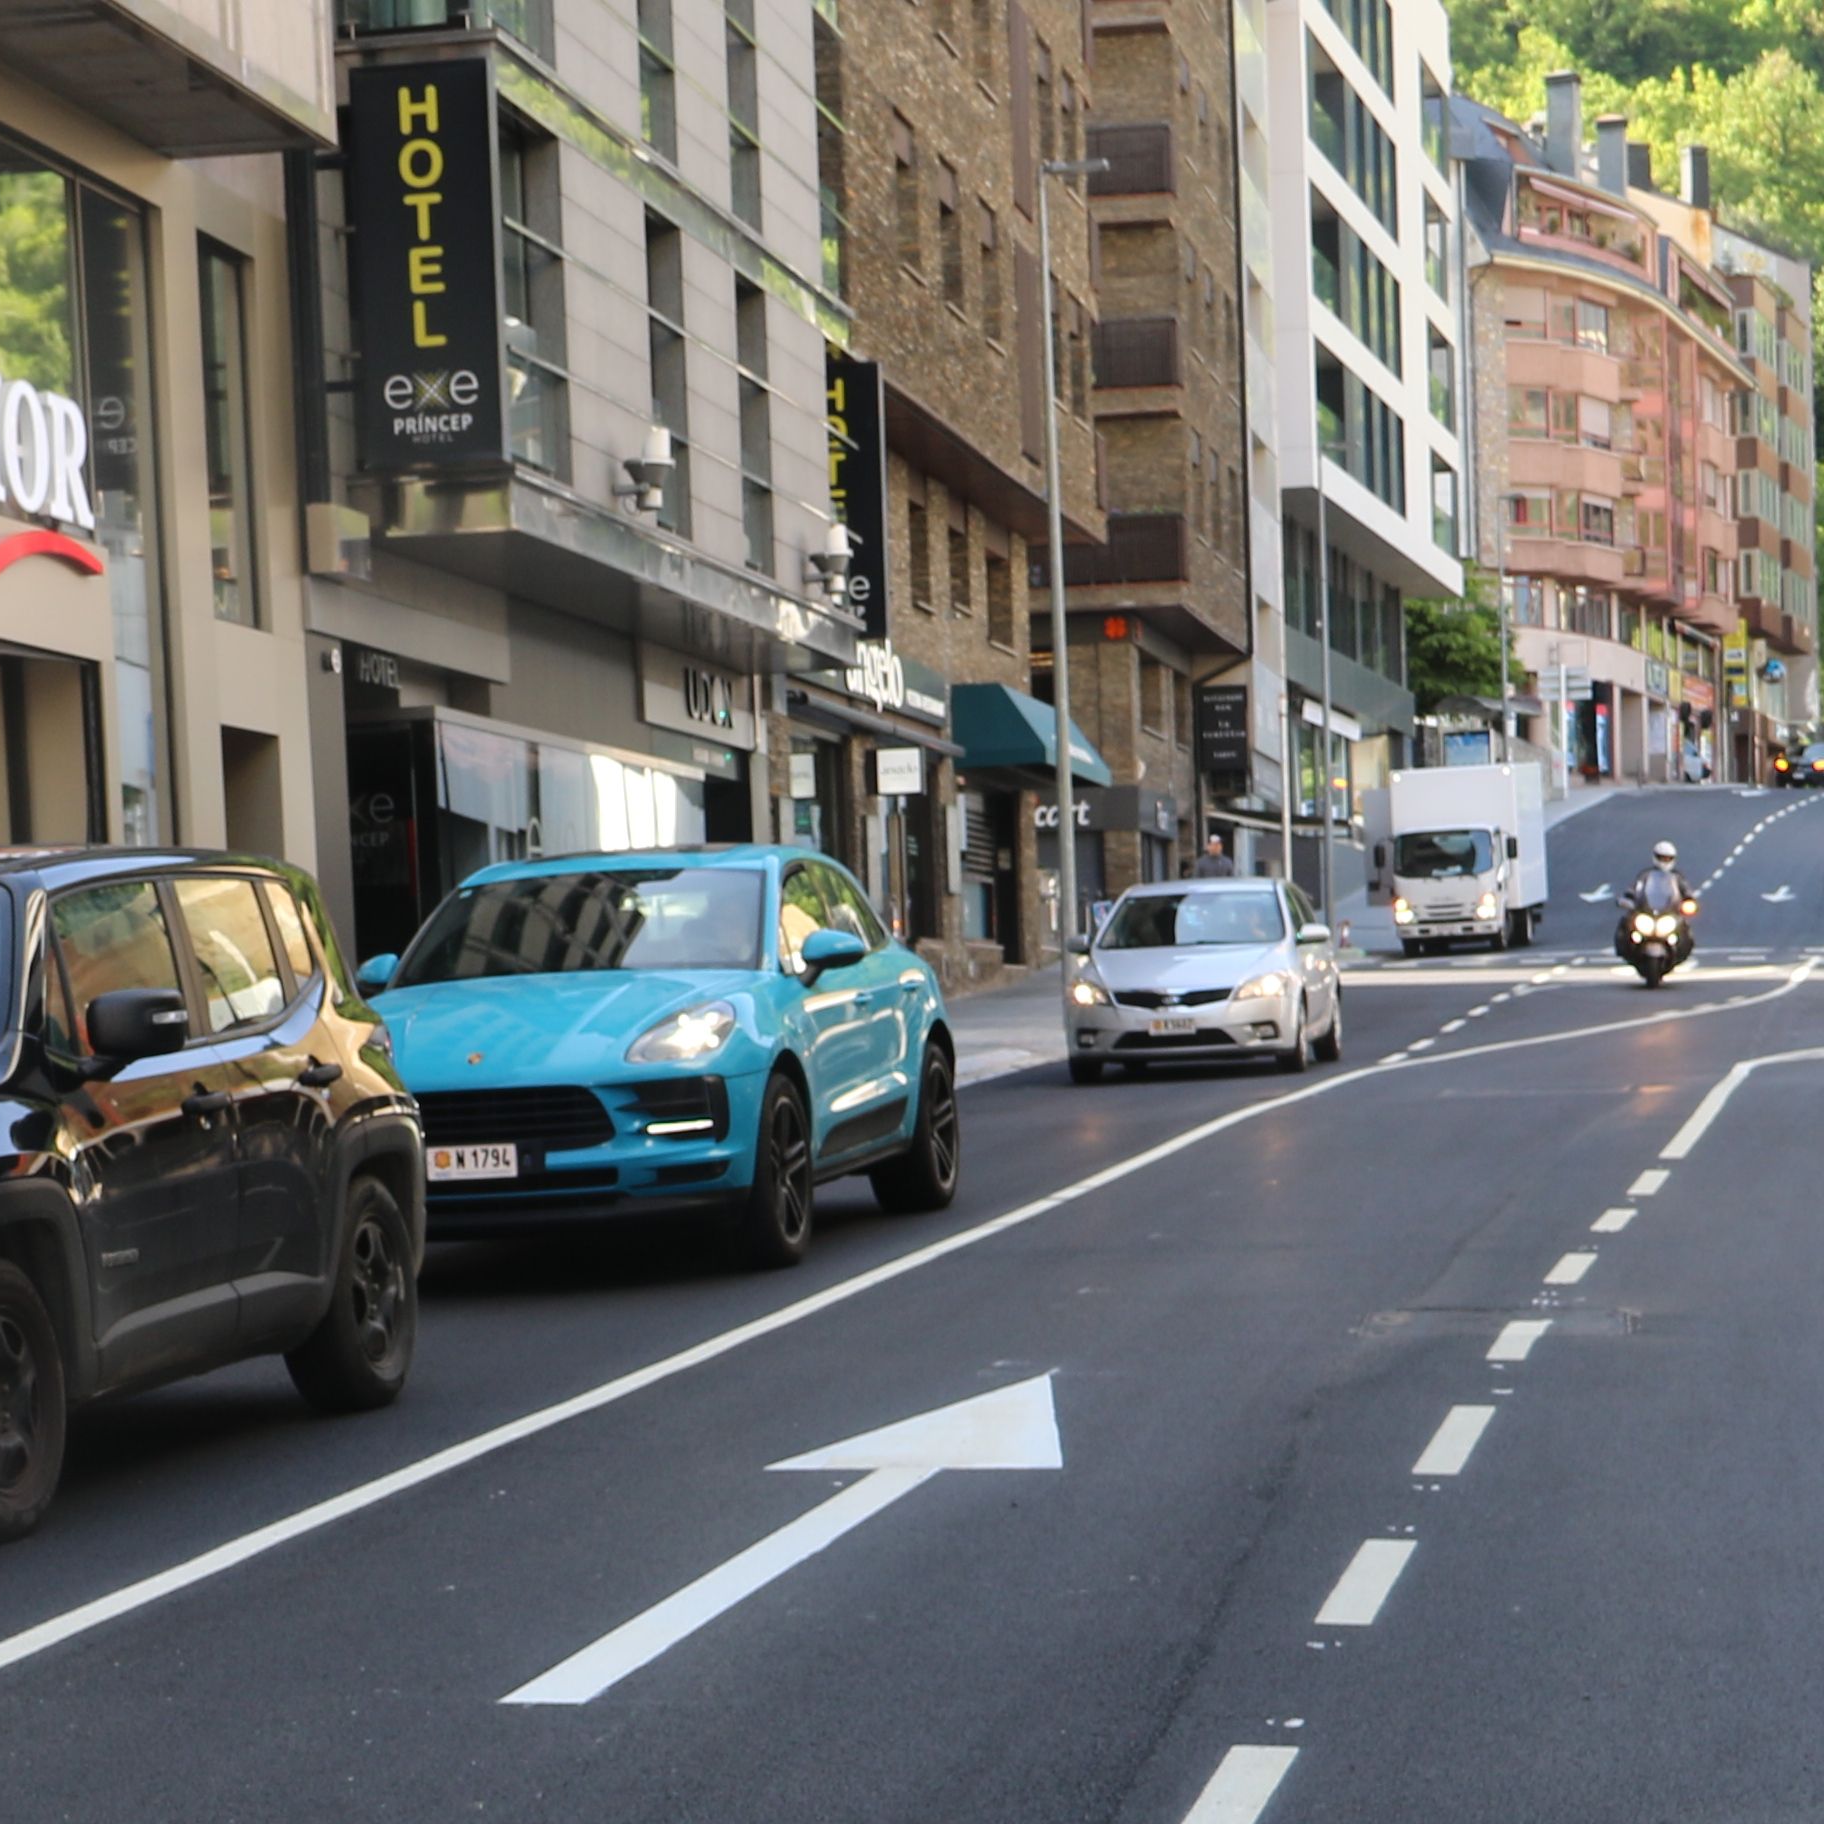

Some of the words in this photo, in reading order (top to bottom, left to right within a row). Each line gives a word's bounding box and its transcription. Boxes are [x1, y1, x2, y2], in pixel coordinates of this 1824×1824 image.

[398, 83, 447, 348] HOTEL
[392, 412, 474, 436] PRÍNCEP
[359, 651, 402, 690] HOTEL
